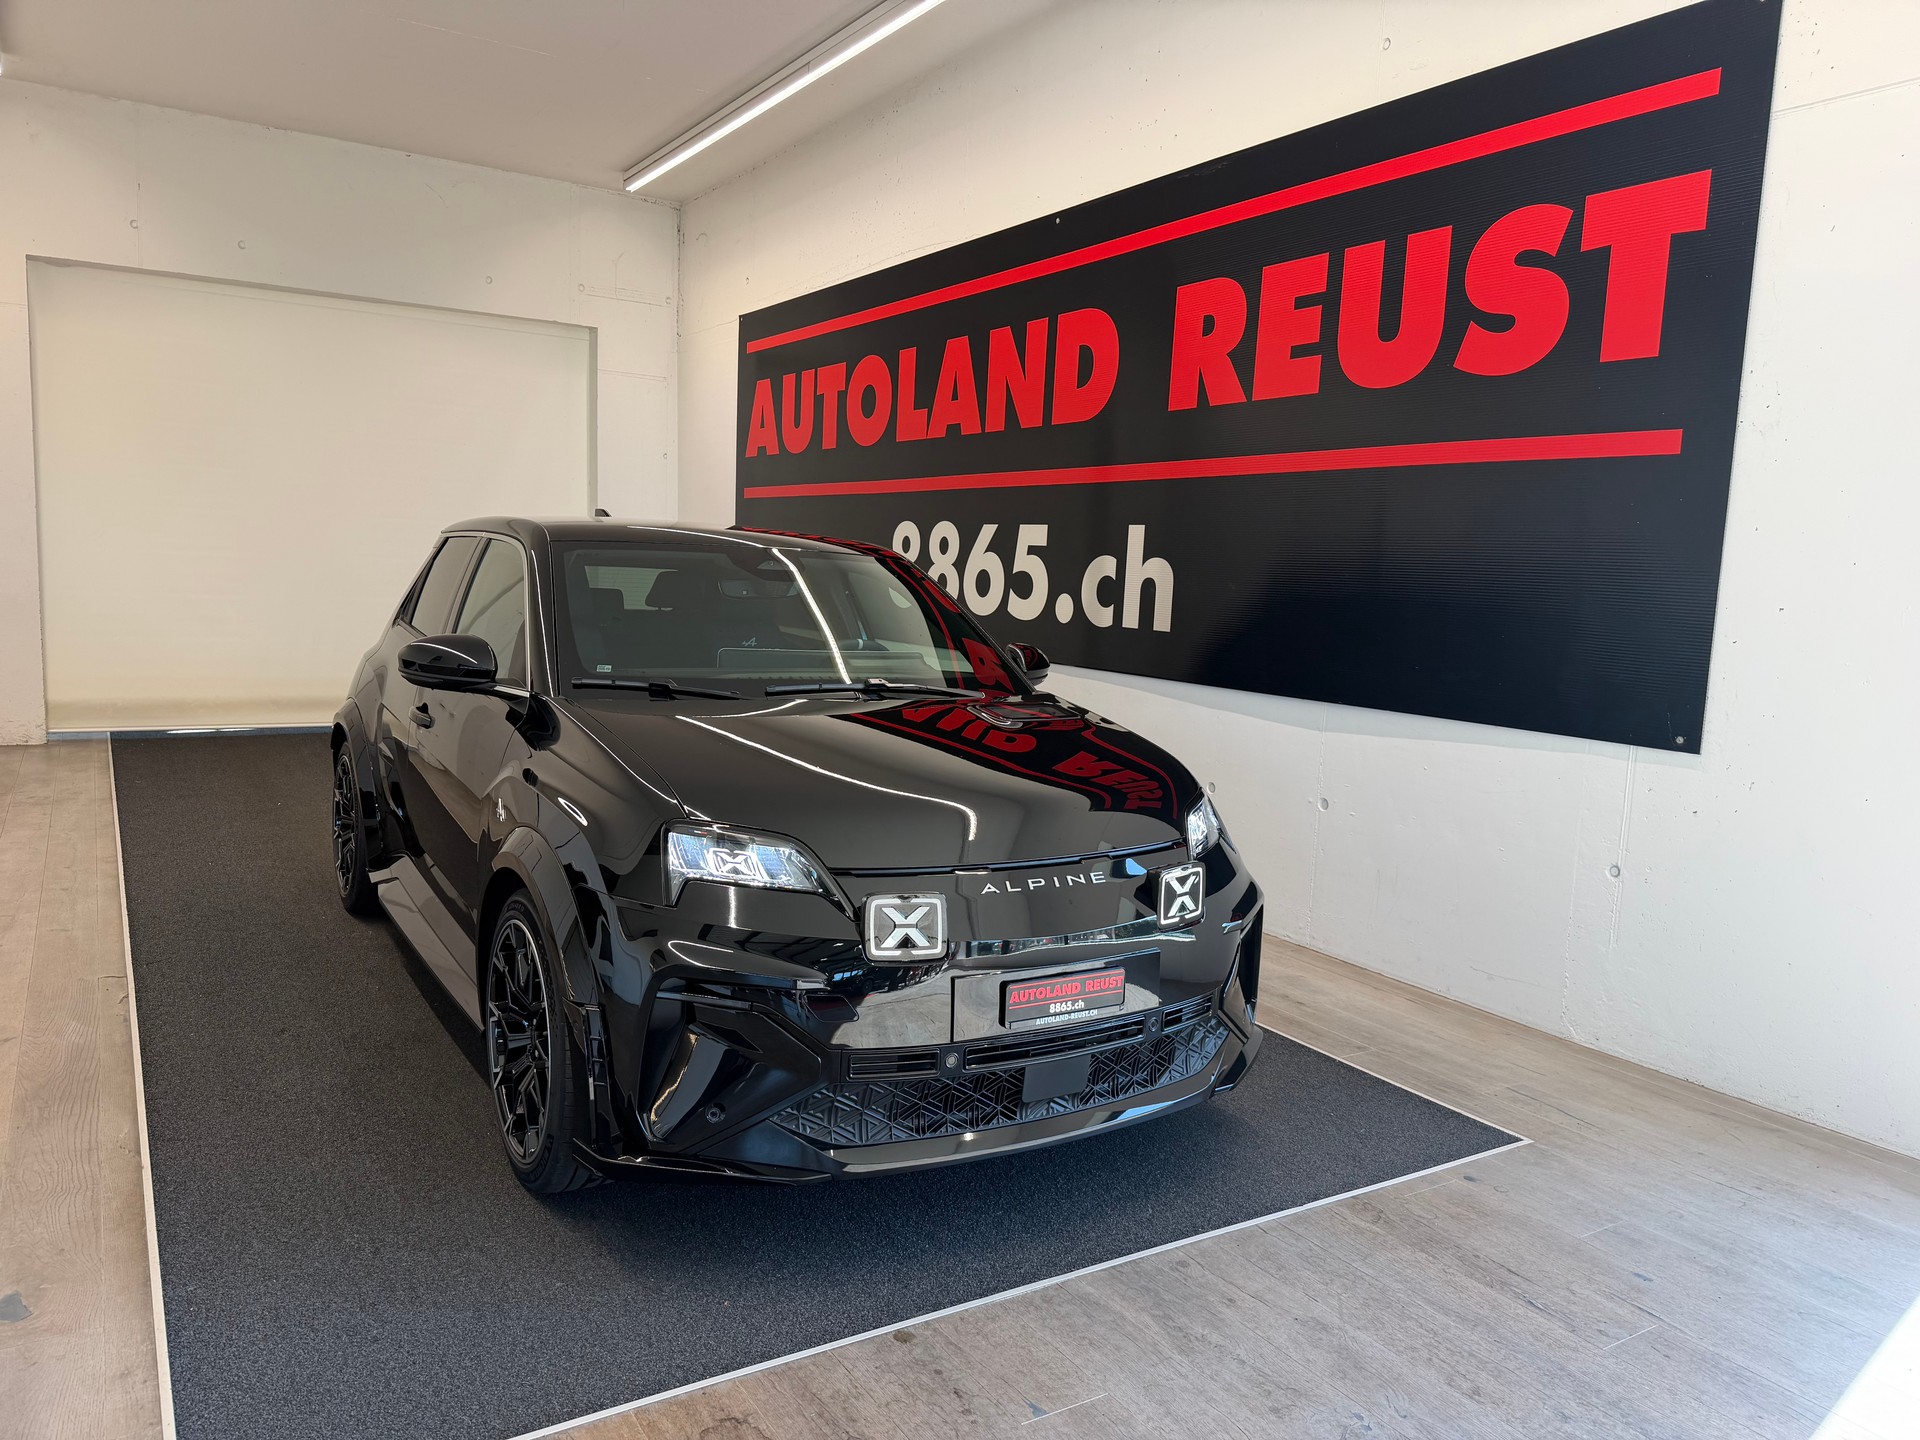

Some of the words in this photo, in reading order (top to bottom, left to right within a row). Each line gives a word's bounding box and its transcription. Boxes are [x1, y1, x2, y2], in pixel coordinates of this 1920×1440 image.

[745, 307, 1121, 459] AUTOLAND
[1167, 169, 1713, 412] REUST
[980, 871, 1107, 895] ALPINE
[1009, 982, 1082, 1004] AUTOLAND
[1085, 975, 1124, 992] REUST
[1035, 1009, 1098, 1026] AUTOLAND-REUST.CH
[1049, 999, 1085, 1014] 8865.ch
